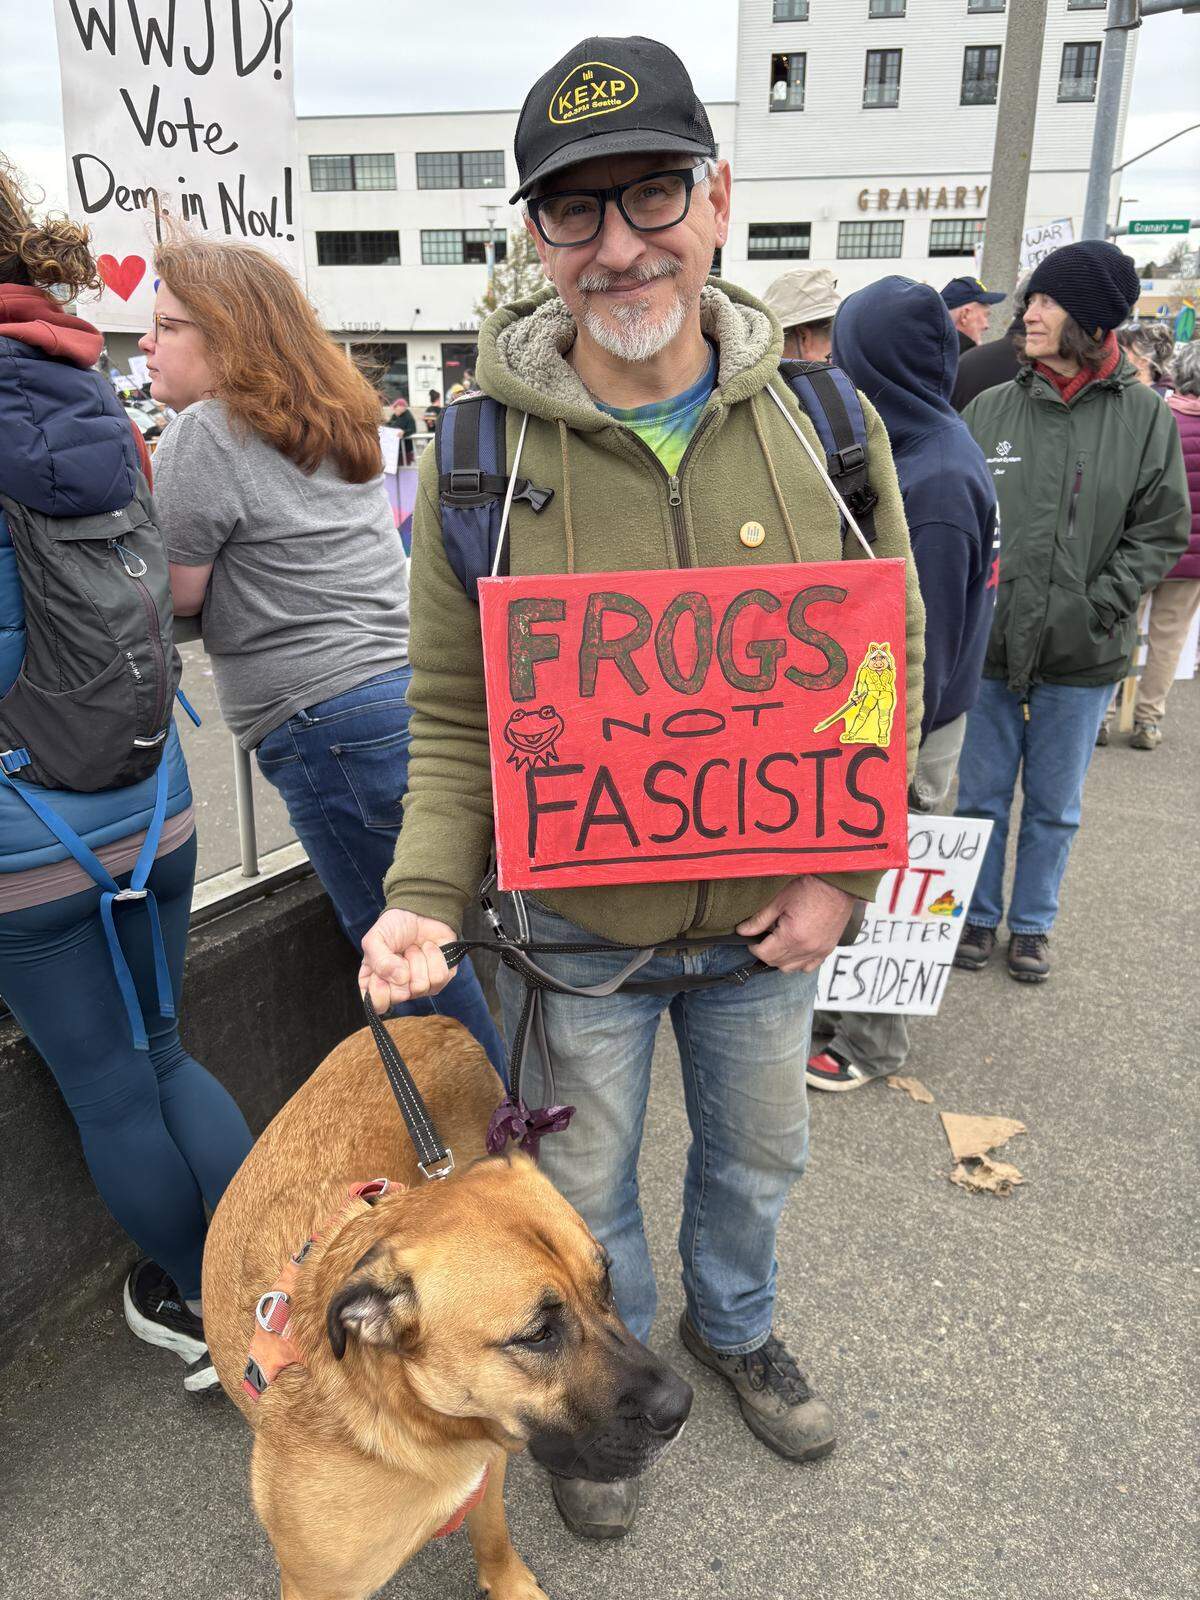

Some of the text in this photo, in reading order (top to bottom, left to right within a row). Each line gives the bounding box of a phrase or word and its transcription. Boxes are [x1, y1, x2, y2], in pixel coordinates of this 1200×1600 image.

[69, 0, 293, 80] WWJD?
[559, 80, 626, 115] KEXP
[591, 99, 622, 109] Seattle
[120, 84, 239, 154] Vote
[178, 176, 208, 230] in
[857, 185, 988, 212] GRANARY
[1025, 224, 1063, 247] WAR
[1134, 223, 1168, 232] Granary
[340, 320, 381, 331] STUDIO
[507, 585, 849, 702] FROGS
[602, 702, 785, 741] NOT
[525, 747, 890, 859] FASCISTS
[853, 919, 951, 947] BETTER
[816, 954, 951, 1006] ESIDENT
